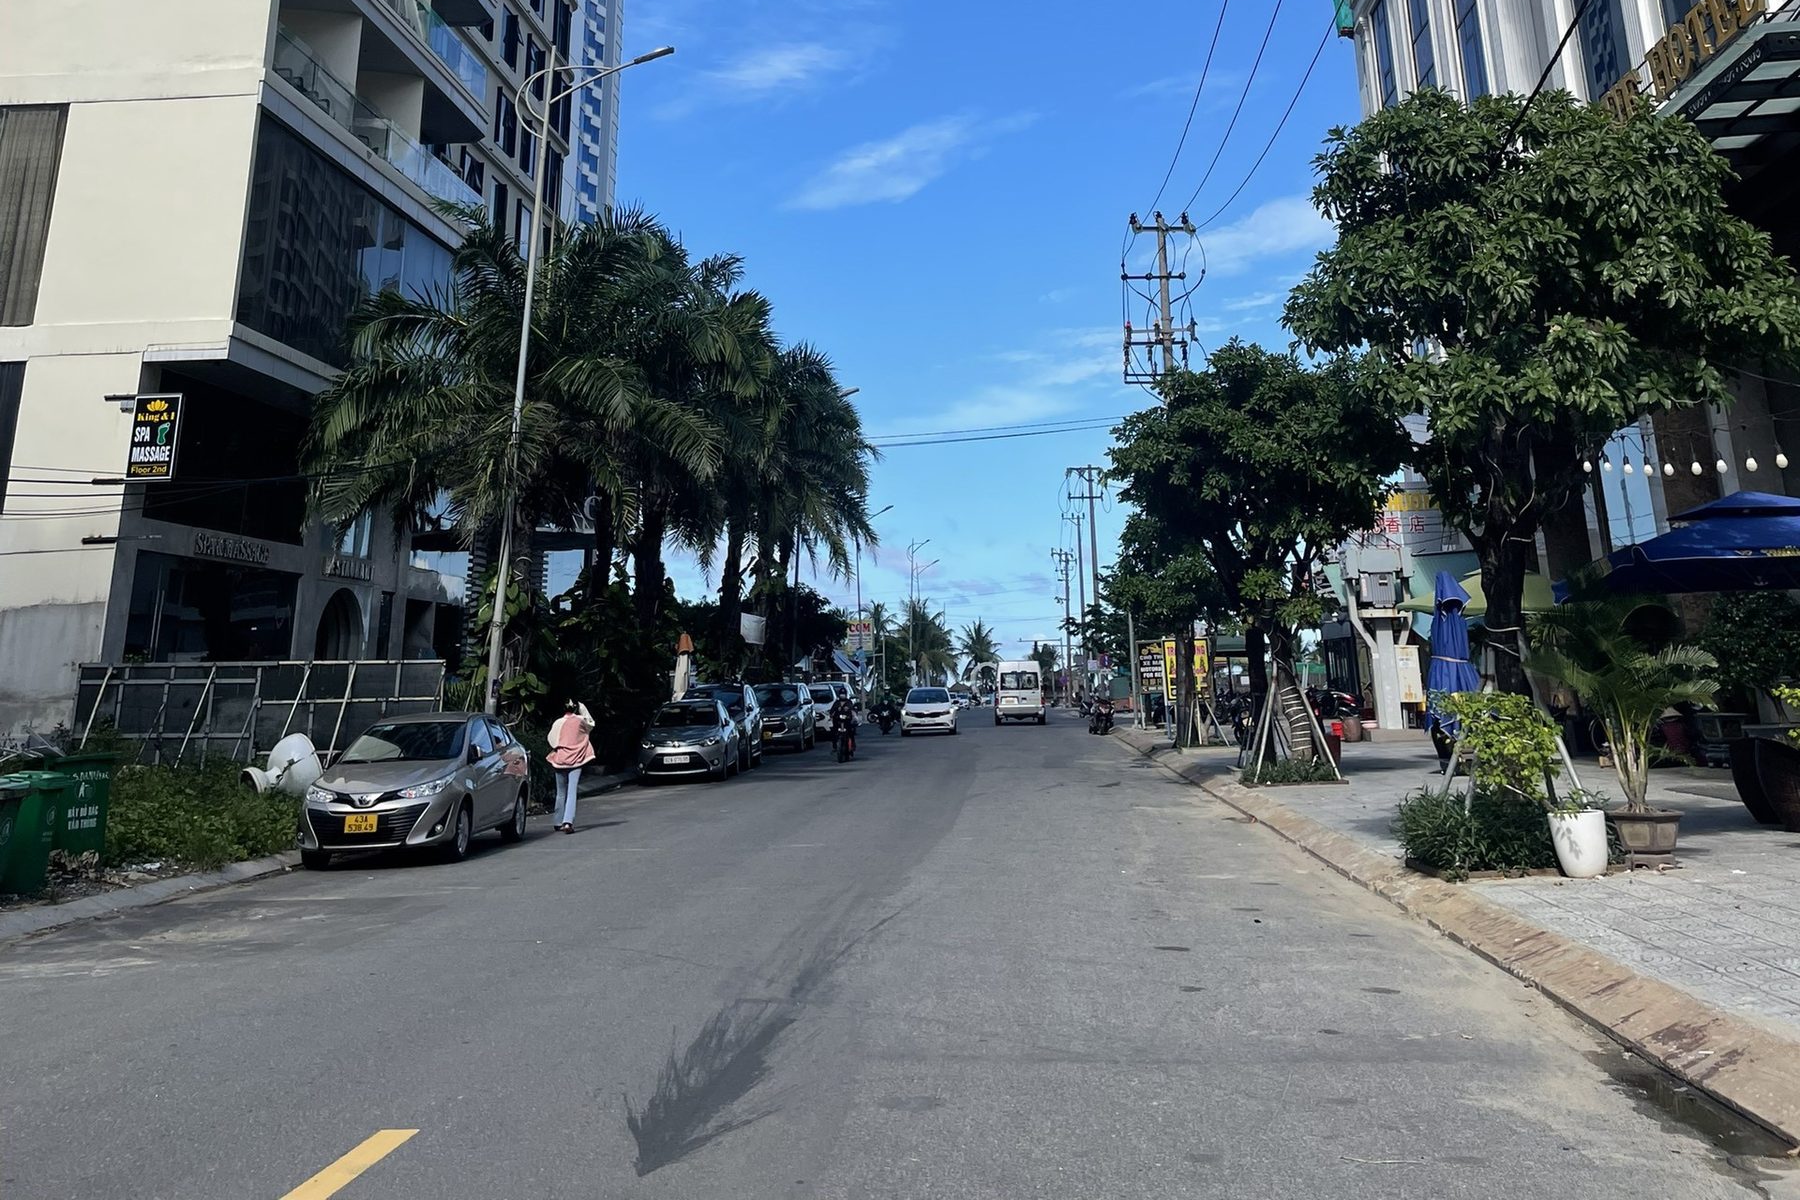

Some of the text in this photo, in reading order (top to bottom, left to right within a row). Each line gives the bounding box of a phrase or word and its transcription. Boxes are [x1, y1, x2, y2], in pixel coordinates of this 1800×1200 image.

[137, 412, 160, 423] King
[161, 411, 169, 420] &
[134, 426, 151, 443] SPA
[131, 445, 171, 462] MASSAGE
[131, 465, 167, 474] Floor 2nd
